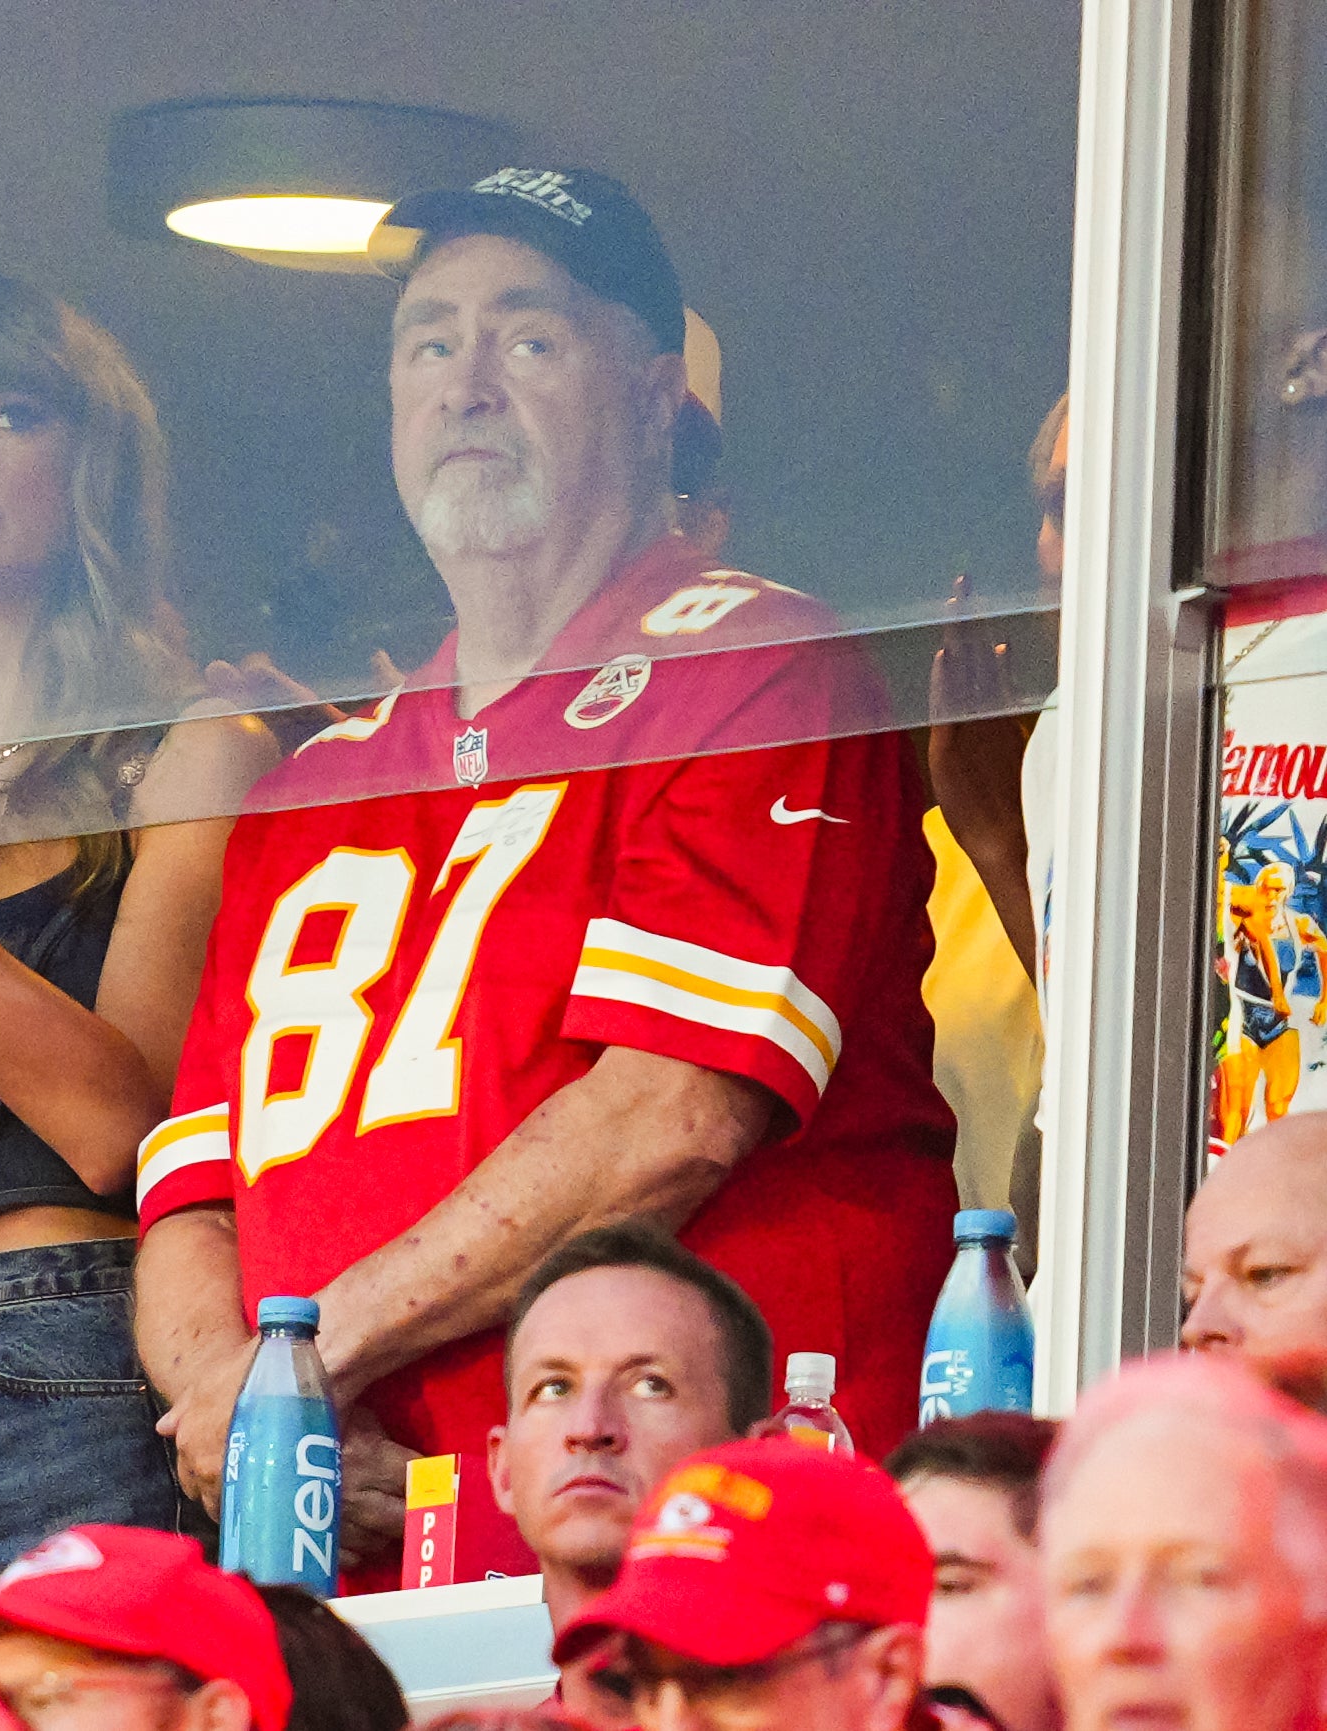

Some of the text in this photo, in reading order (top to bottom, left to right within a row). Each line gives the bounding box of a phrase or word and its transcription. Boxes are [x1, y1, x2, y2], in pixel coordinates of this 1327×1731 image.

[237, 781, 569, 1187] 87
[226, 1432, 242, 1482] zen
[292, 1433, 336, 1577] zen
[419, 1511, 437, 1589] POP
